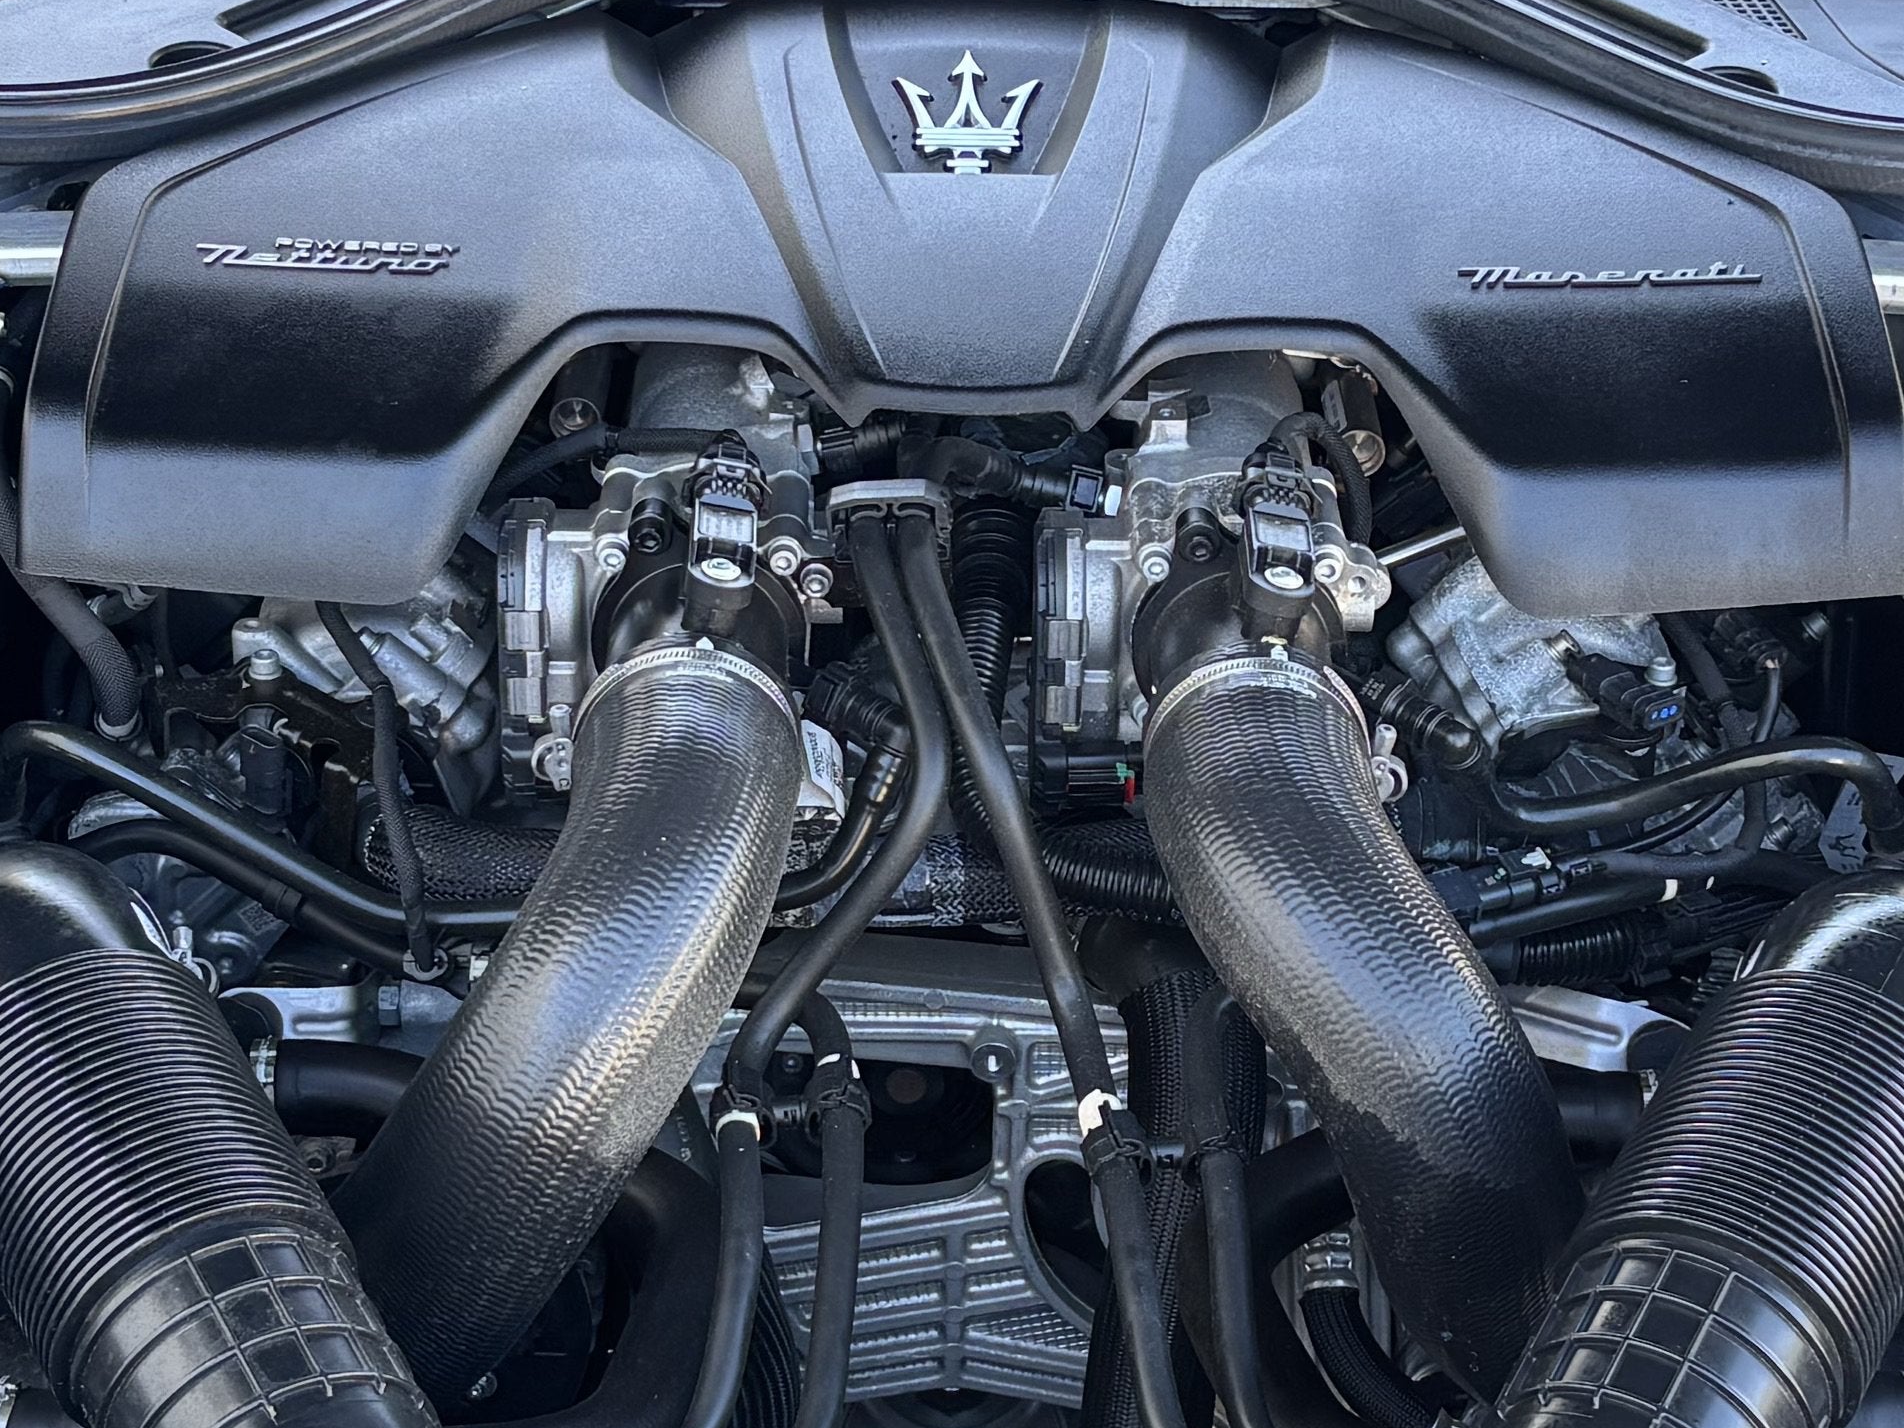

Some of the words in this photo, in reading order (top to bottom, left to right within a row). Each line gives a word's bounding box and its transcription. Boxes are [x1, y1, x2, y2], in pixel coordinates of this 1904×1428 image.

[196, 242, 450, 275] Nettuno
[274, 236, 420, 254] POWERED
[424, 243, 461, 257] BY
[1457, 260, 1763, 289] Maserati
